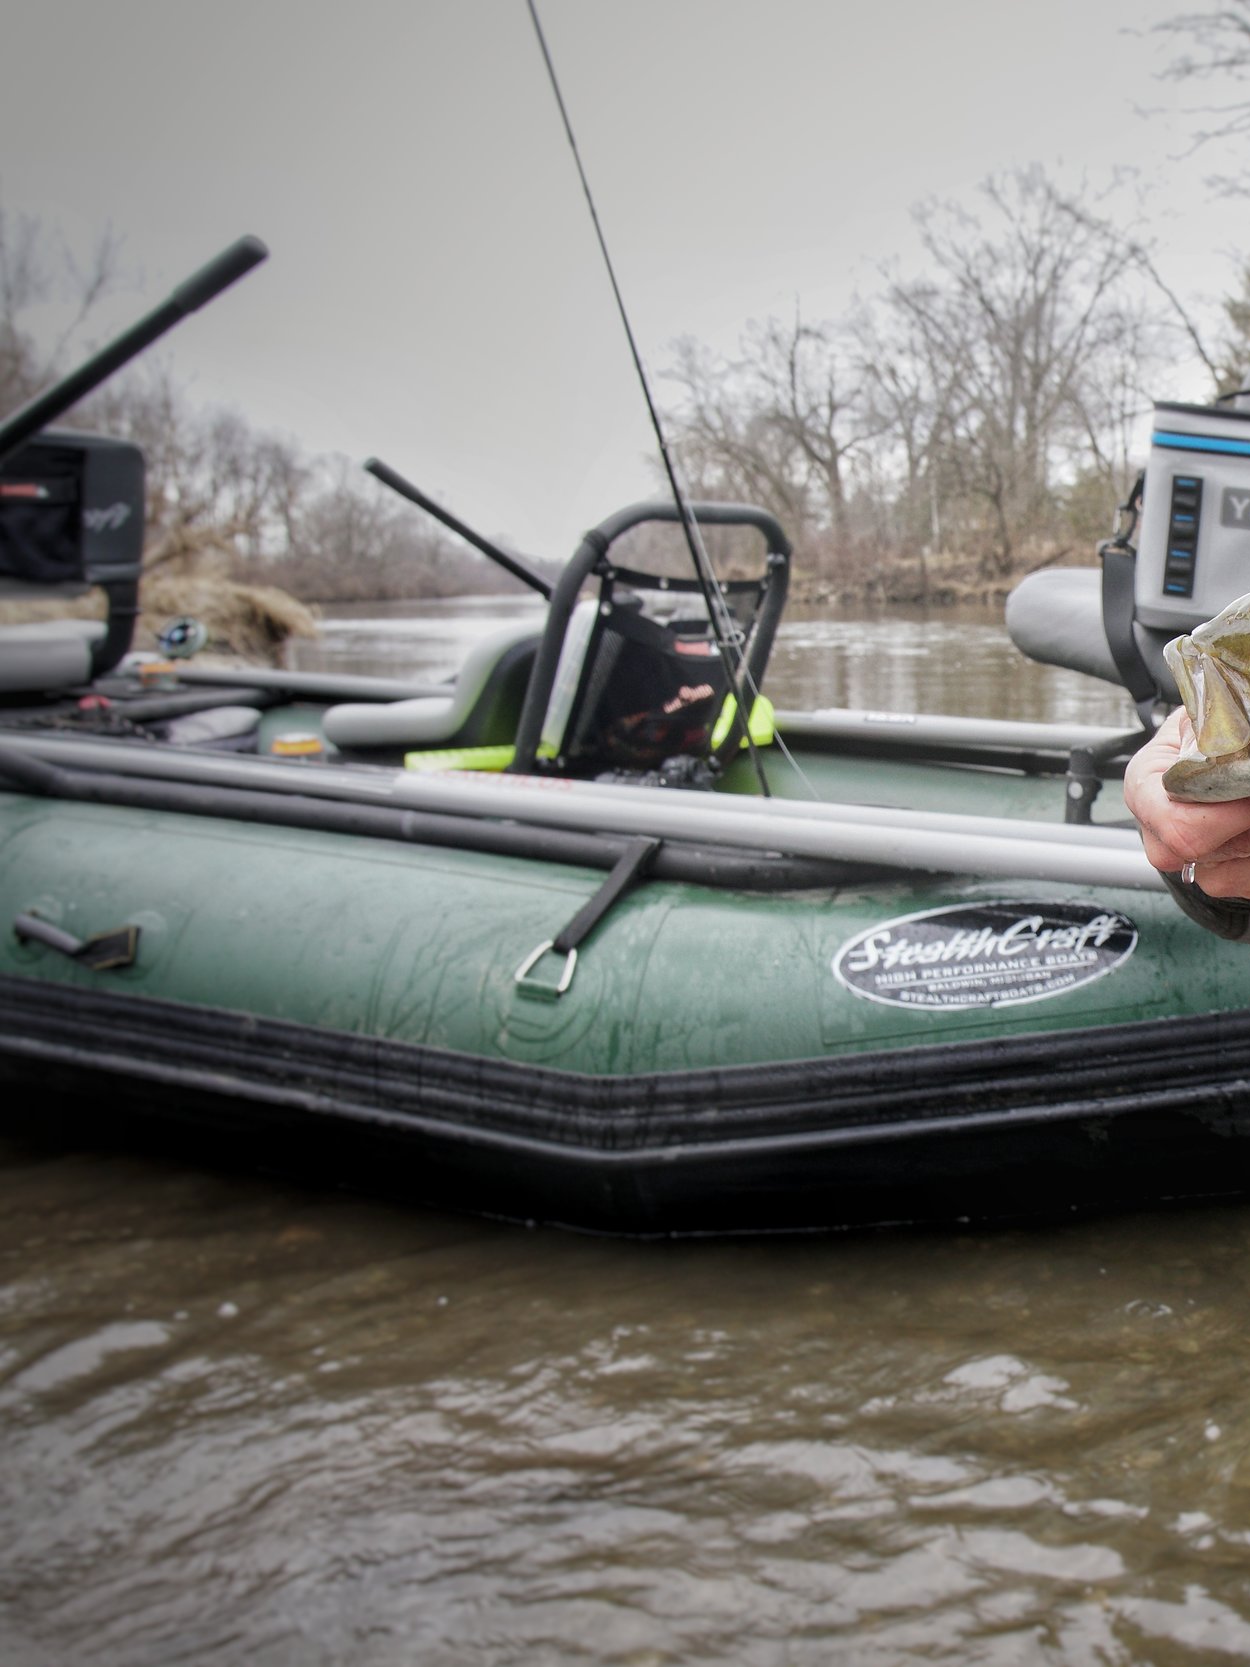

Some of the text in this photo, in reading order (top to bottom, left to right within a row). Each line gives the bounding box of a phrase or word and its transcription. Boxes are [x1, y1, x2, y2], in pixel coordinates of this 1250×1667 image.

[874, 949, 1098, 985] HIGH PERFORMANCE BOATS
